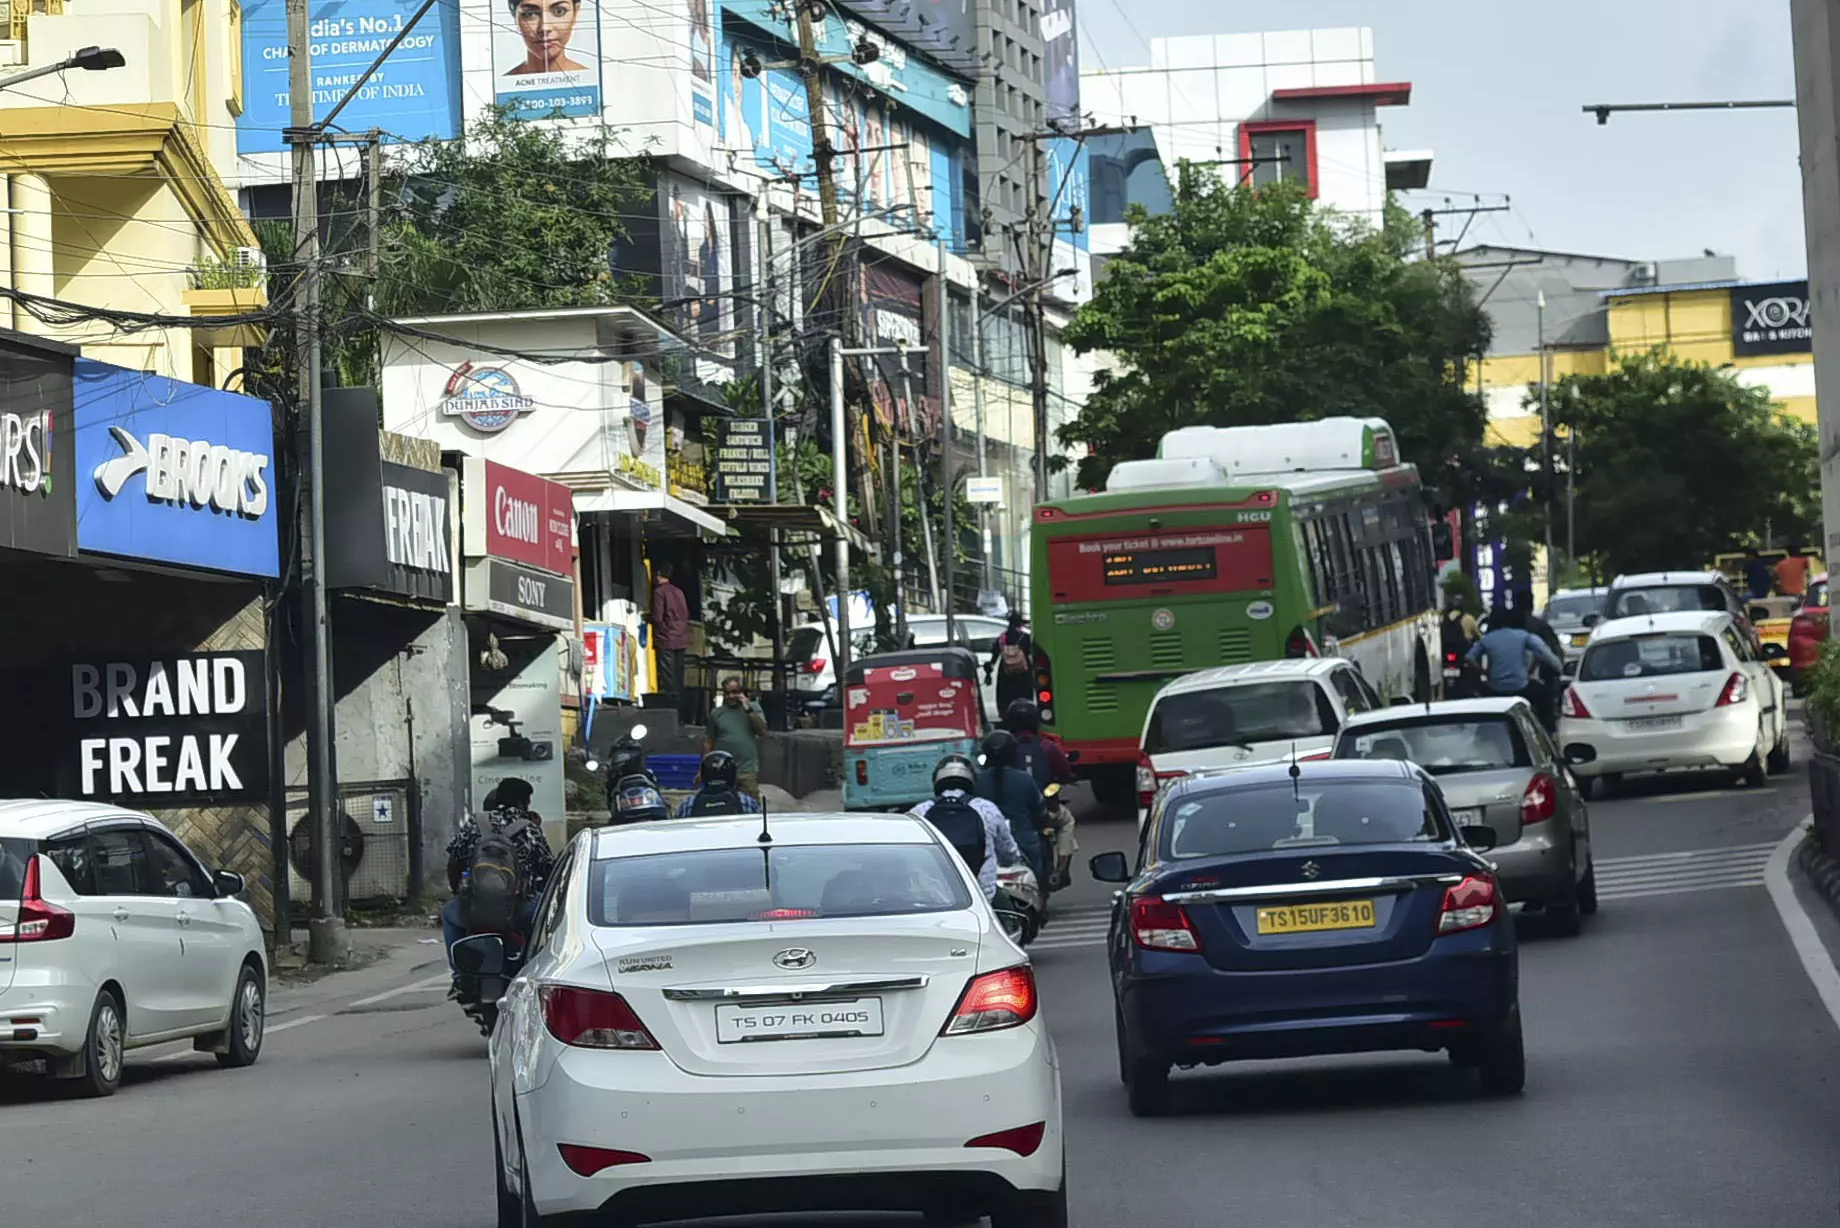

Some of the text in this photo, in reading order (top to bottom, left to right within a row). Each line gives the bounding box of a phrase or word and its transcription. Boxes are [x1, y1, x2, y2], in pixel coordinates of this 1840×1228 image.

[311, 14, 404, 38] dia's No.1
[310, 43, 329, 57] OF
[311, 88, 352, 104] TIME
[360, 85, 381, 100] OF
[382, 83, 425, 99] INDIA
[515, 78, 536, 87] ACNE
[145, 432, 270, 517] BROOKS
[494, 484, 539, 545] Canon
[382, 485, 450, 574] FREAK
[1079, 542, 1101, 554] Book
[1102, 541, 1122, 553] your
[517, 575, 547, 608] SONY
[71, 656, 247, 720] BRAND
[80, 733, 244, 796] FREAK
[1266, 905, 1371, 929] TS15UF3610
[731, 1011, 870, 1029] TS 07 FK 0405
